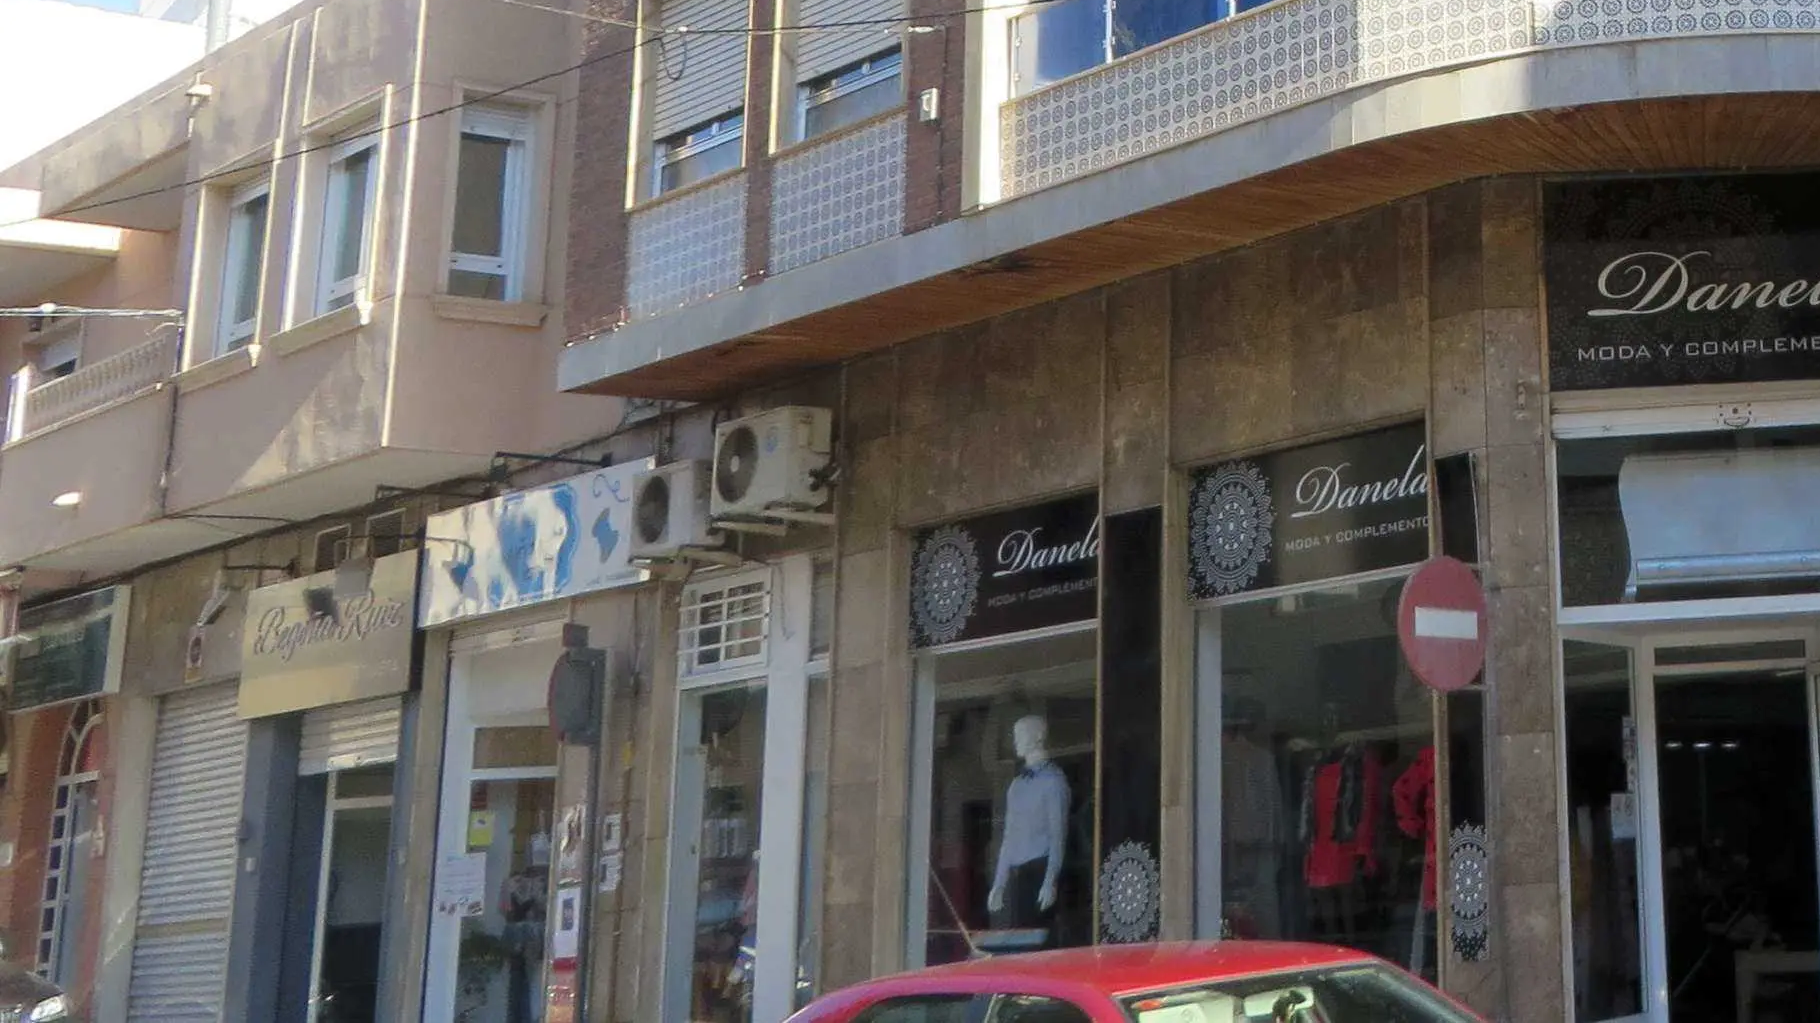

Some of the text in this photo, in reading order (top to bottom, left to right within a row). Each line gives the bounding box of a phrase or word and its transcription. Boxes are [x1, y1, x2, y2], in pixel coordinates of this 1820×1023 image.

[1578, 344, 1651, 362] MODA
[1660, 343, 1675, 358] Y
[1290, 443, 1428, 519] Danela
[1284, 515, 1429, 553] MODA Y COMPLEMENTO
[1028, 577, 1099, 600] COMPLEMENT
[337, 589, 405, 642] Ruiz
